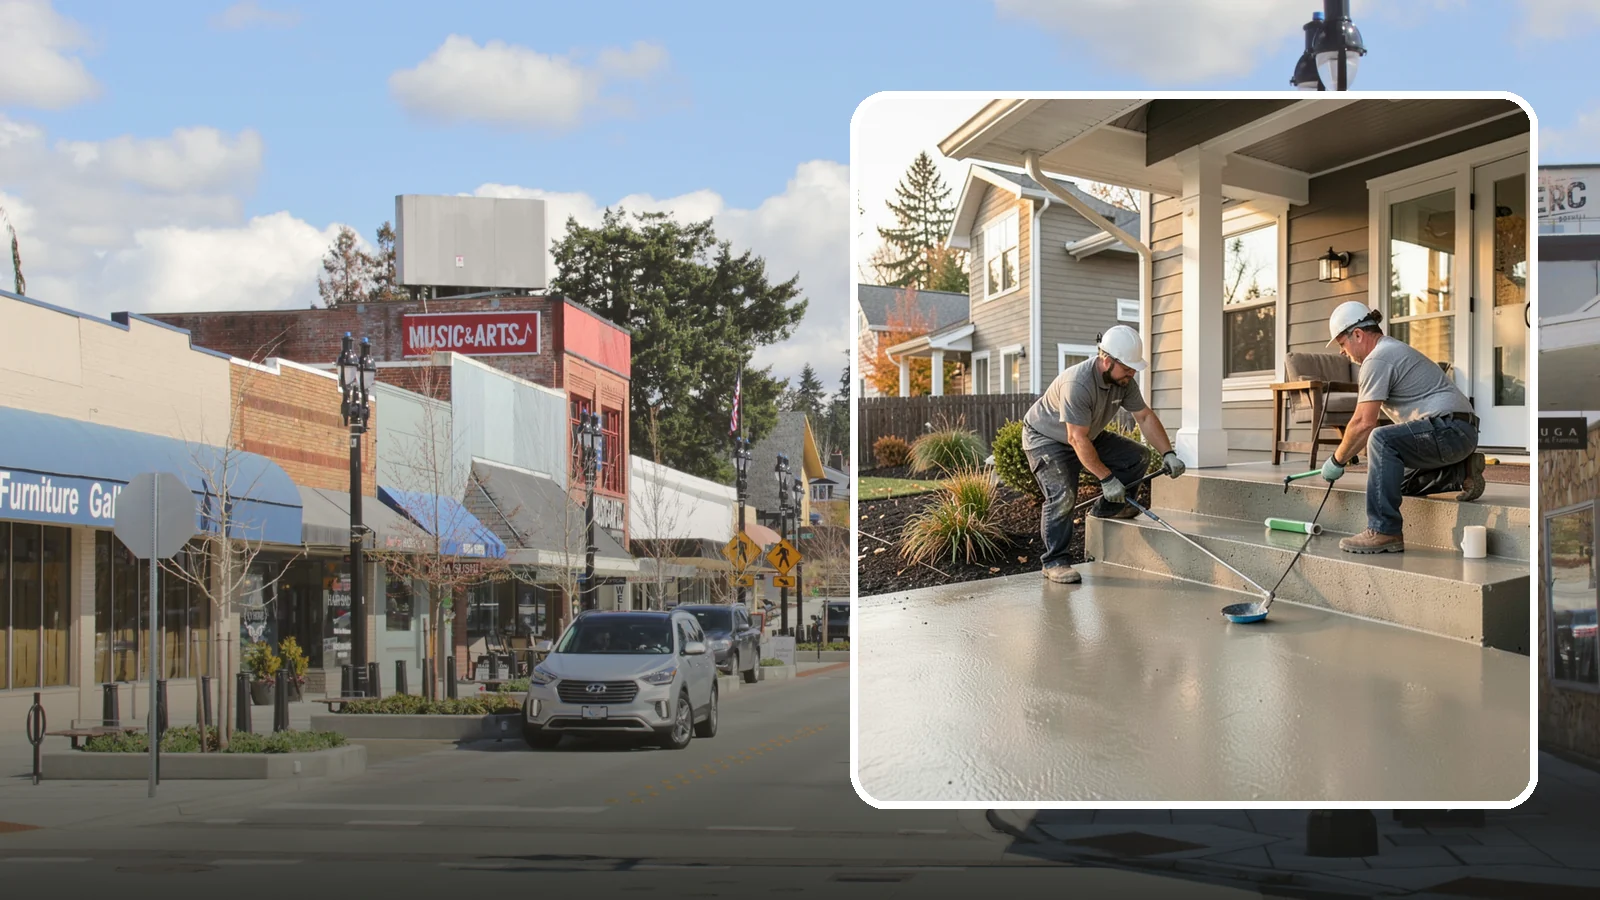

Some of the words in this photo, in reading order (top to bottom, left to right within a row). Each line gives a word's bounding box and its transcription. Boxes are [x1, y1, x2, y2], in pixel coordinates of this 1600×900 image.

[408, 322, 520, 349] MUSIC&ARTS
[0, 471, 79, 515] Furniture
[453, 563, 480, 574] SUSHI
